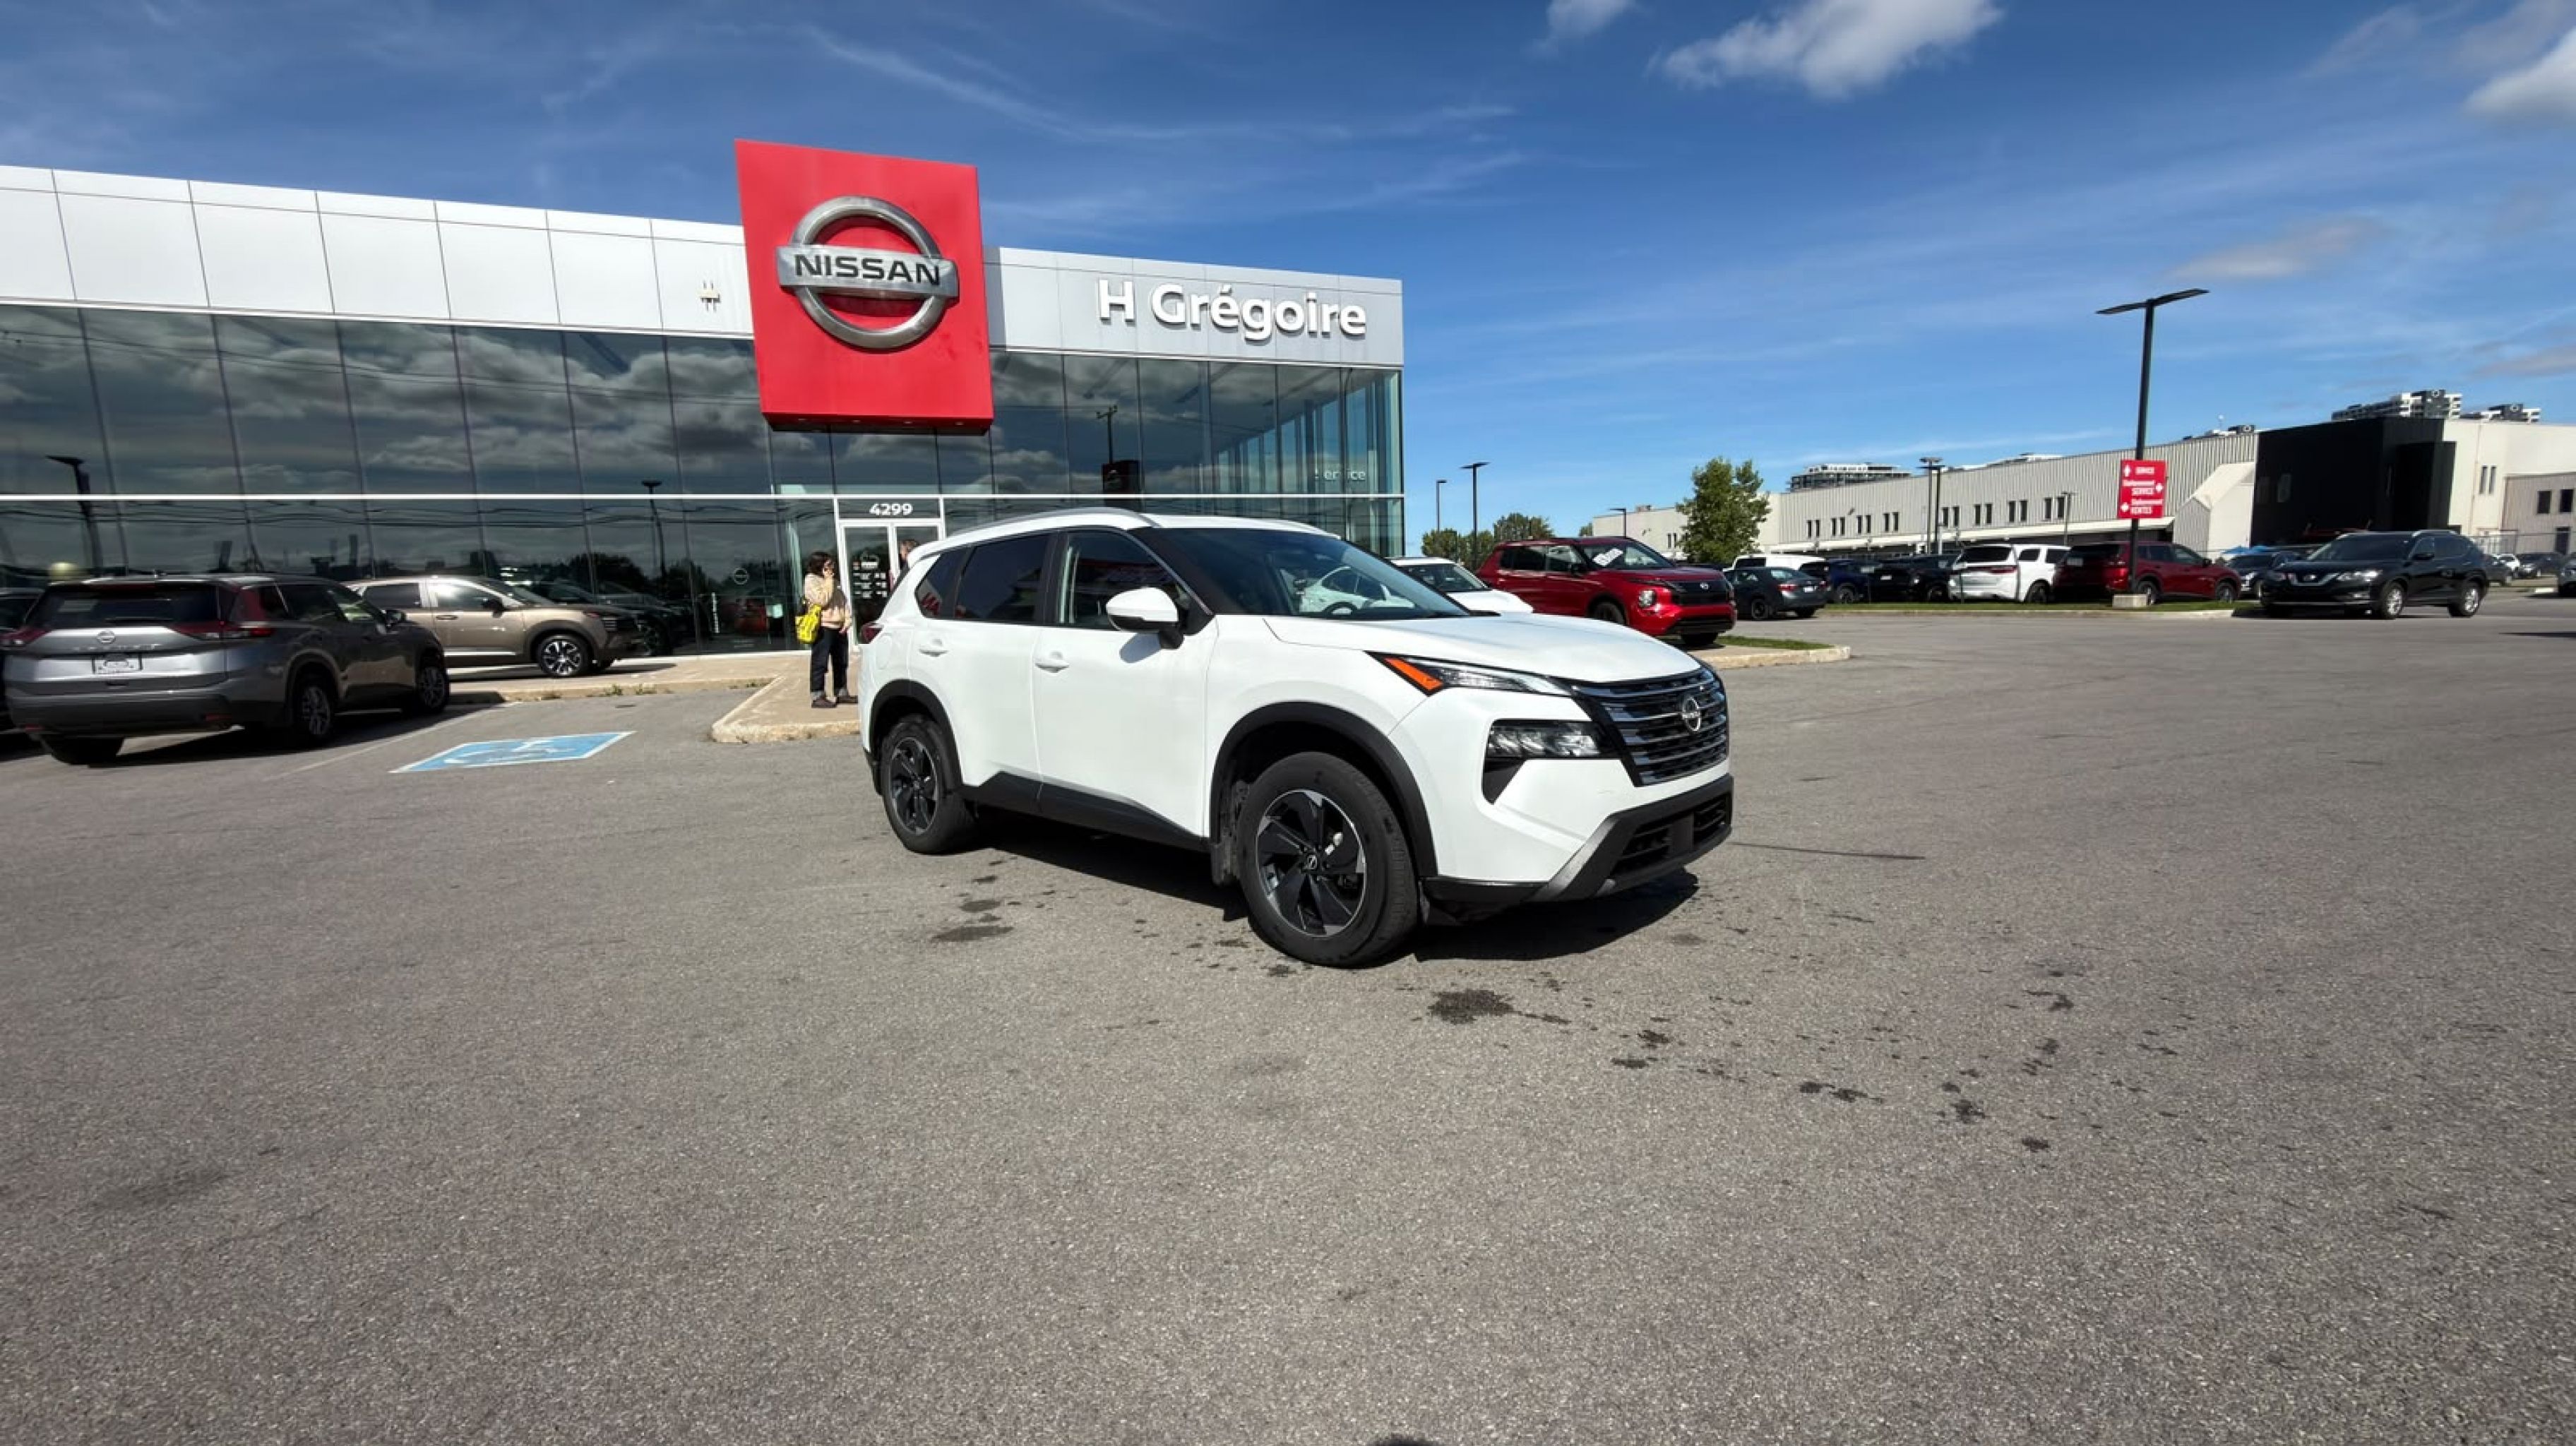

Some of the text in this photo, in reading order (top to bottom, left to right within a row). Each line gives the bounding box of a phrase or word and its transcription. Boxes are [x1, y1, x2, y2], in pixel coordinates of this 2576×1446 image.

[795, 253, 941, 286] NISSAN
[1099, 280, 1366, 343] H Grégoire
[1313, 467, 1366, 481] erice
[869, 503, 914, 516] 4299
